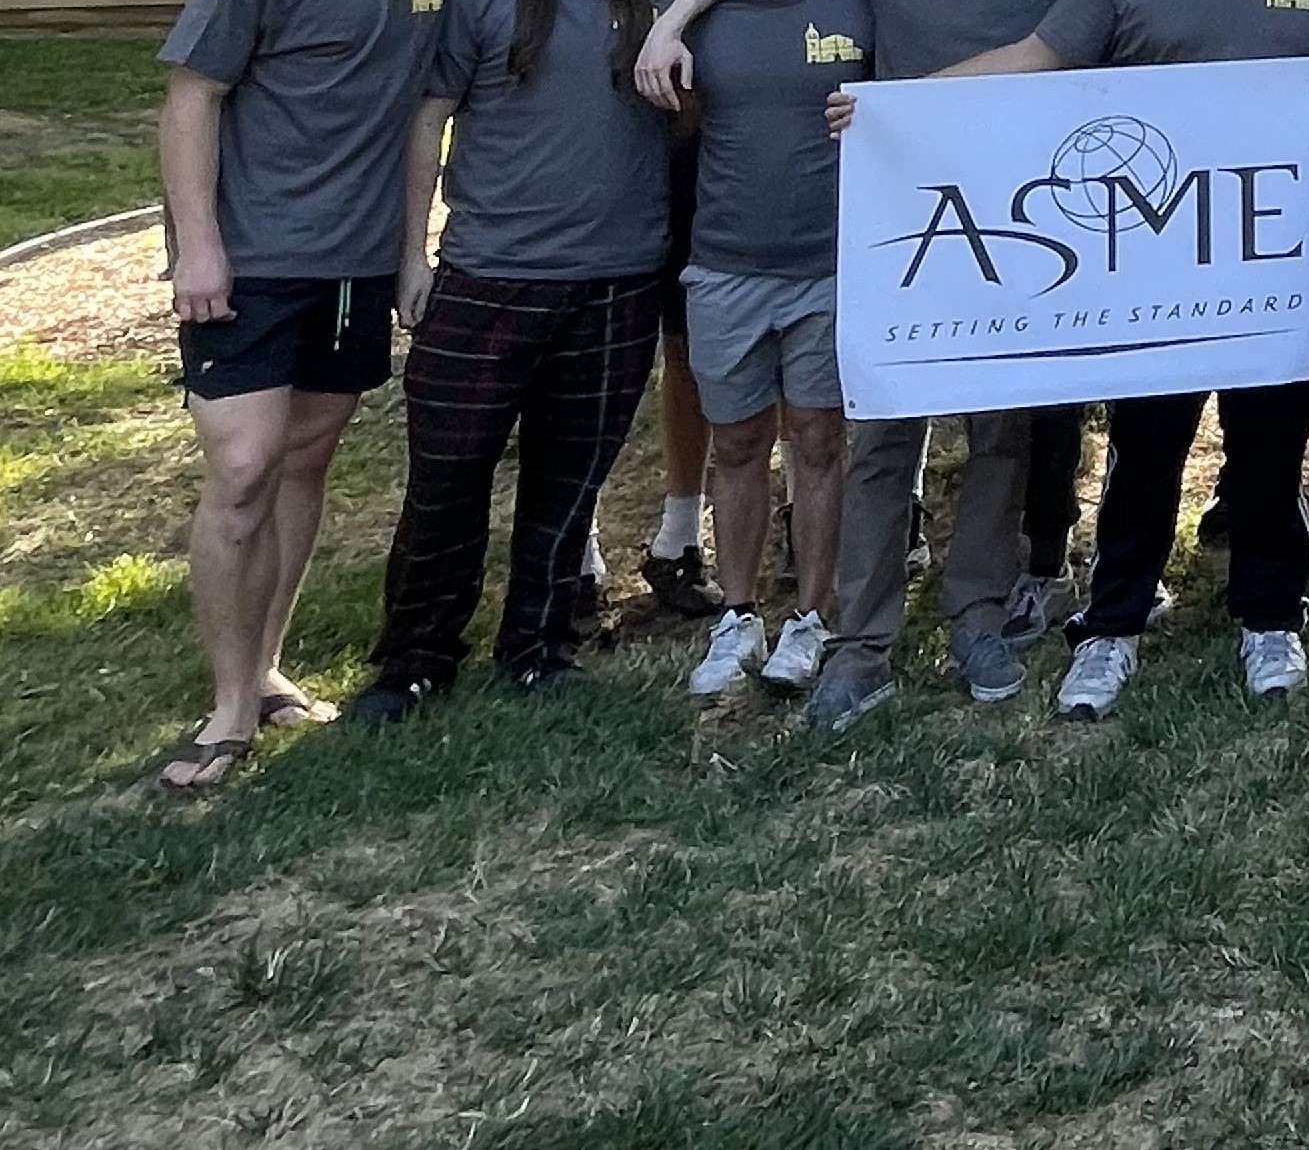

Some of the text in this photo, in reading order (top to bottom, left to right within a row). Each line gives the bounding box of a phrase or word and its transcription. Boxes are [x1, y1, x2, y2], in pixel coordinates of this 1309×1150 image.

[869, 163, 1303, 298] ASME
[884, 293, 1303, 342] SETTING THE STANDARD
